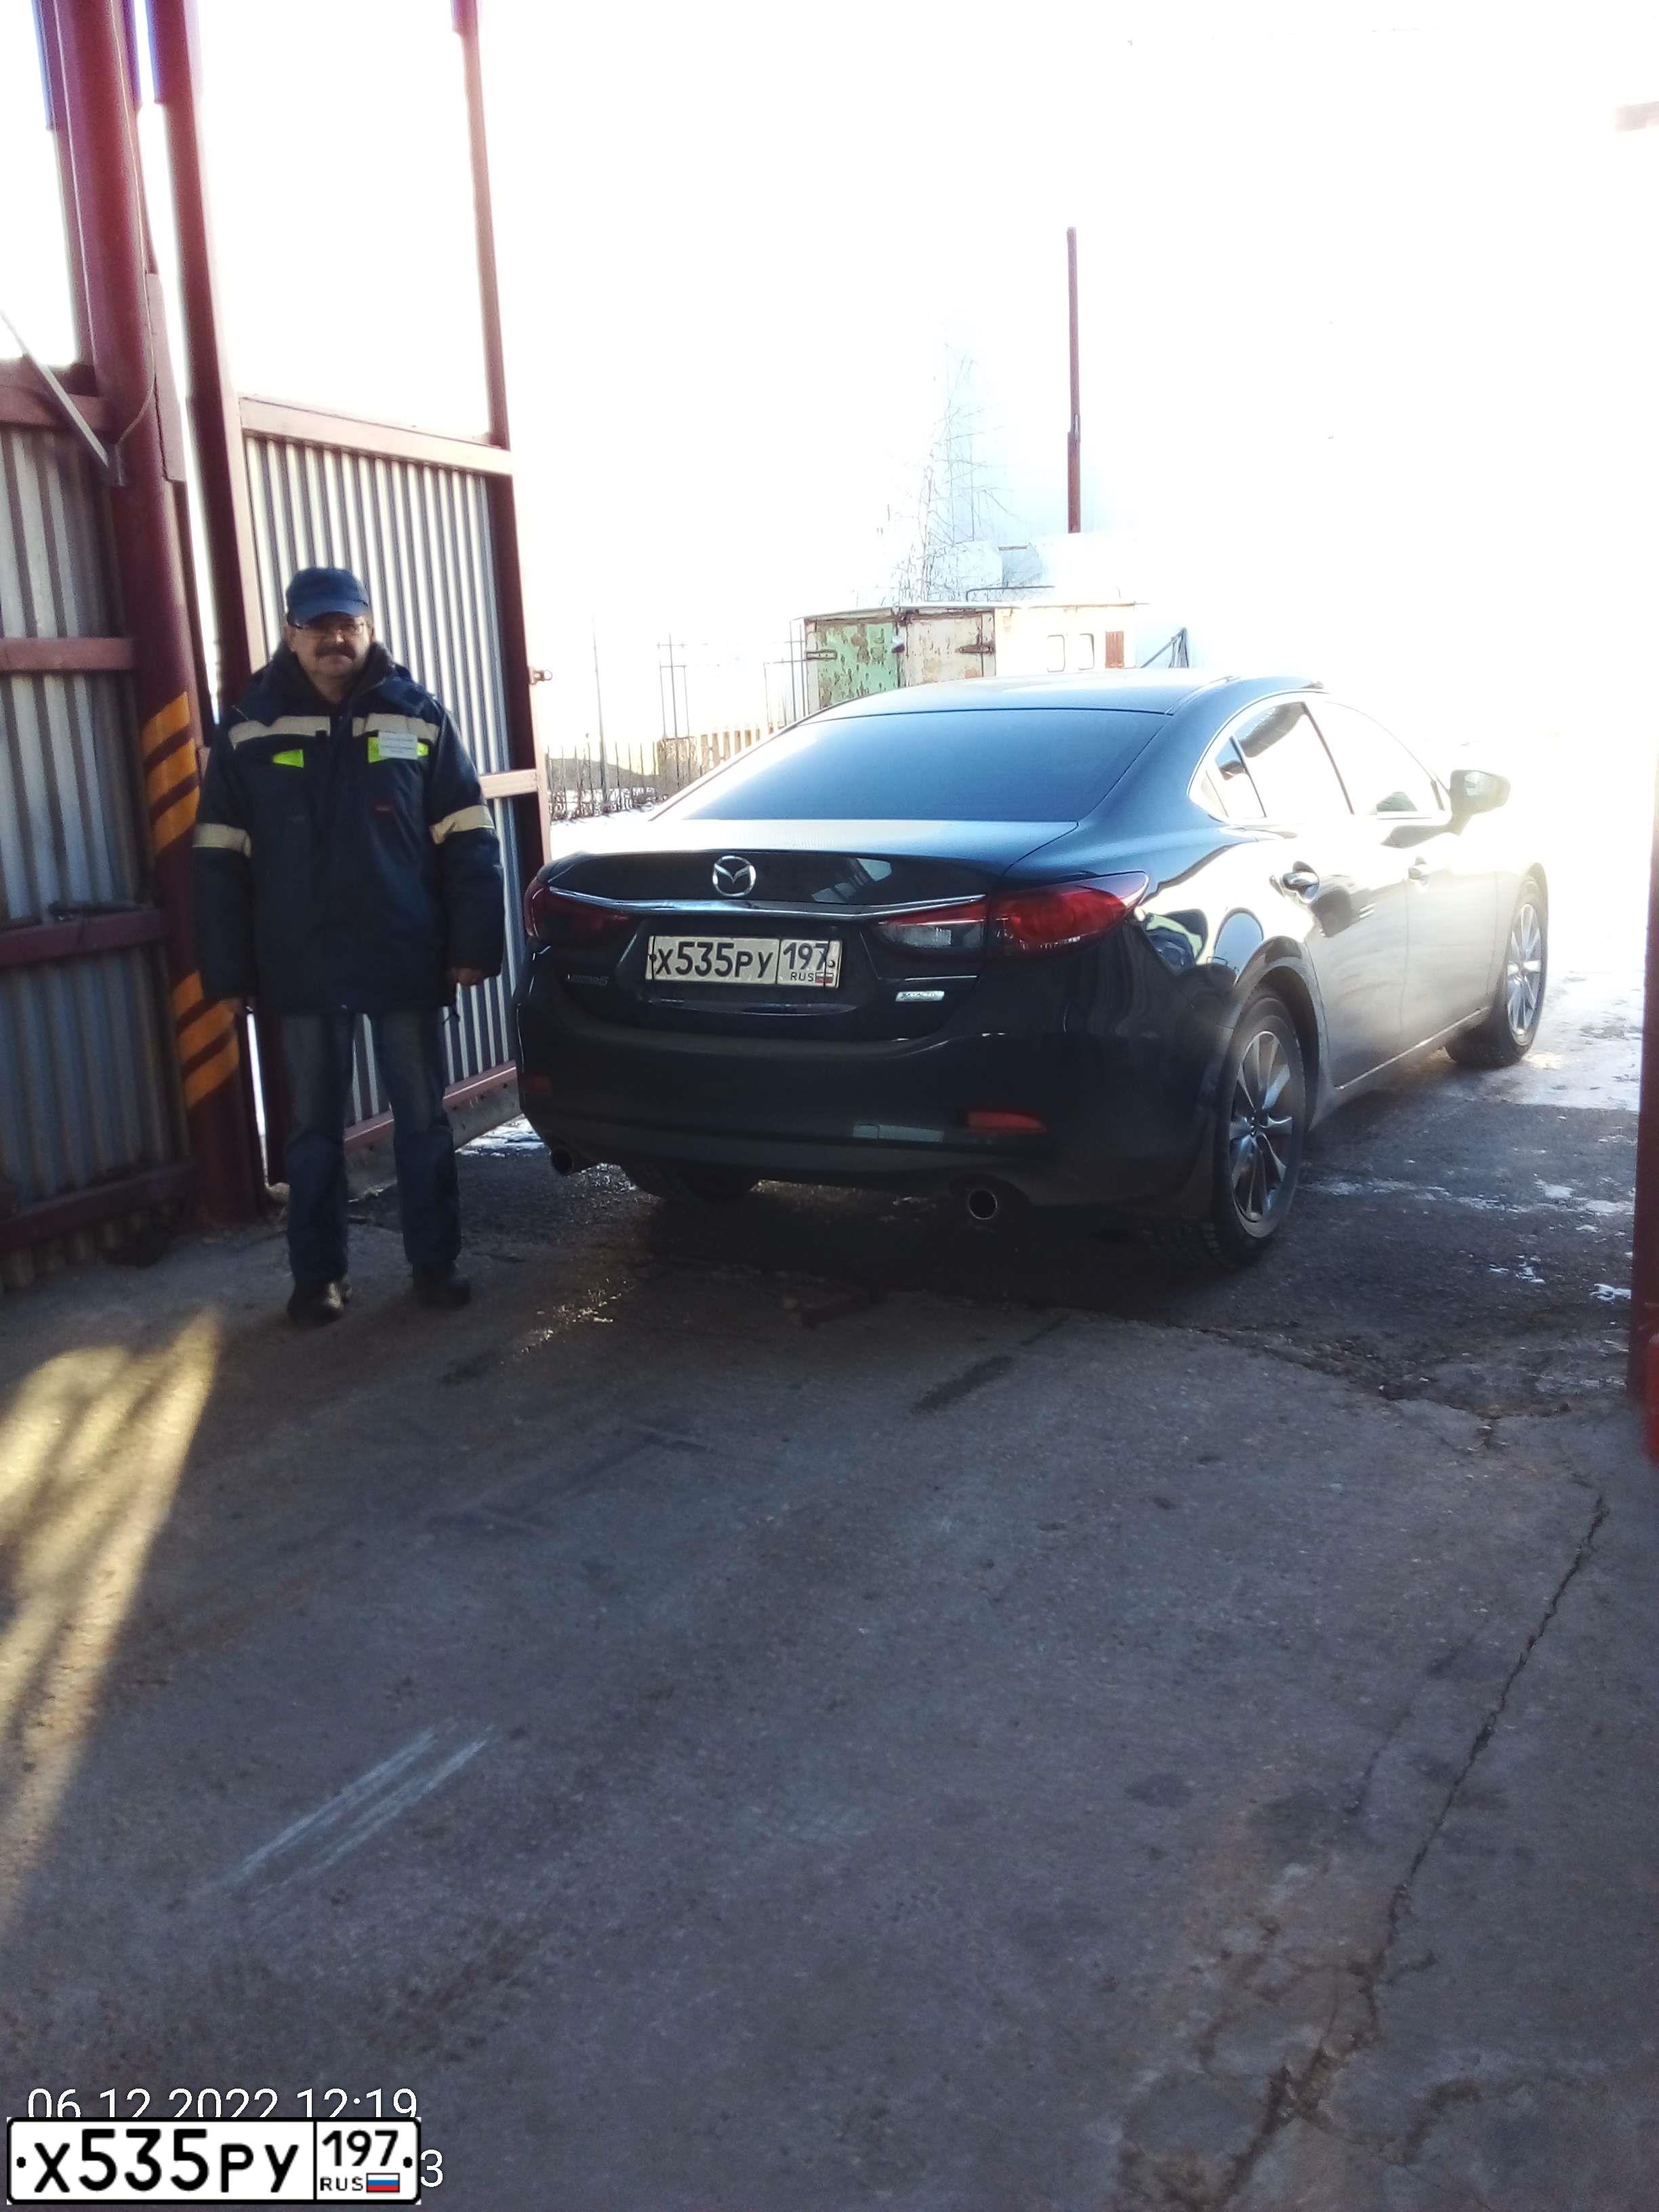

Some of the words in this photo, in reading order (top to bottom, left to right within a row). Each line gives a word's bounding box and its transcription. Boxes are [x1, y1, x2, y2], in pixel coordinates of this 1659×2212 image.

[655, 941, 774, 979] Х535РУ
[783, 942, 829, 970] 197
[790, 972, 815, 982] RUS
